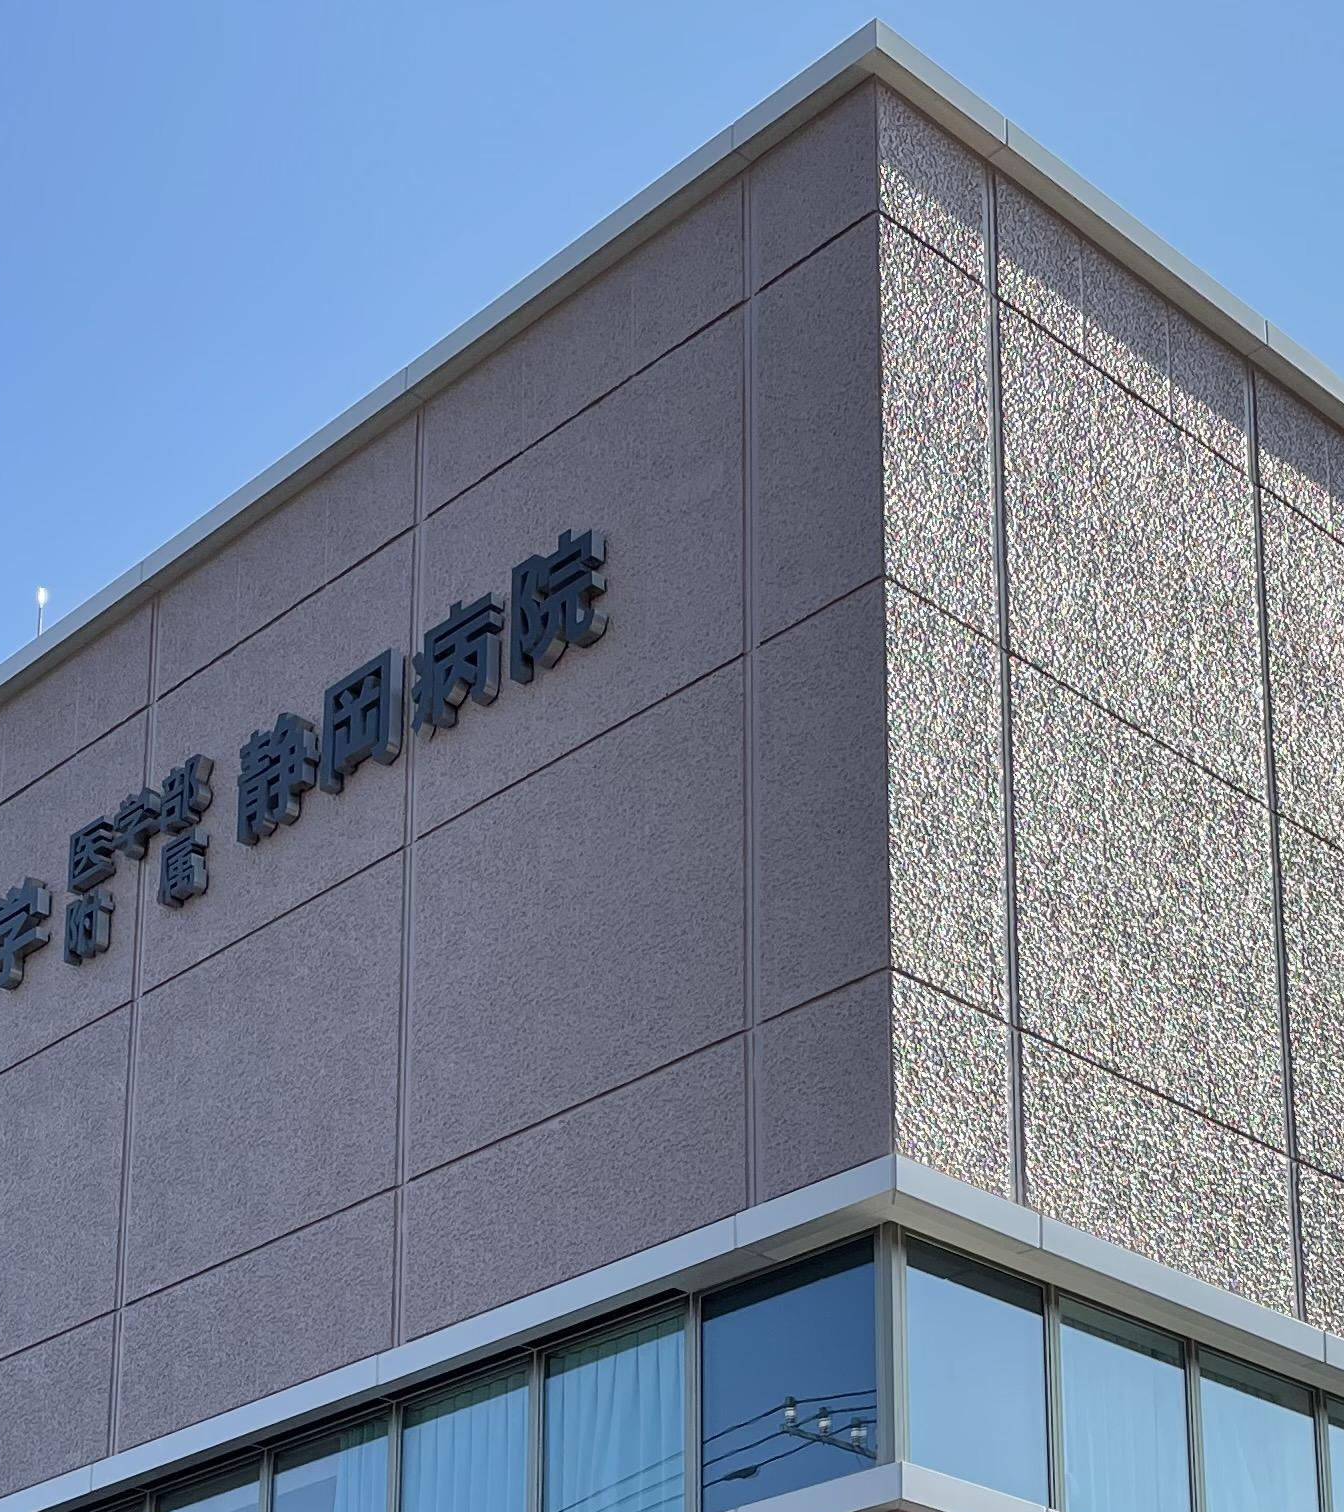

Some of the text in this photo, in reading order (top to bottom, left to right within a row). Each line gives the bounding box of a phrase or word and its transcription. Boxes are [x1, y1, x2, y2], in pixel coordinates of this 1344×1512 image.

[237, 529, 608, 847] 静岡病院
[67, 754, 214, 895] 医学部
